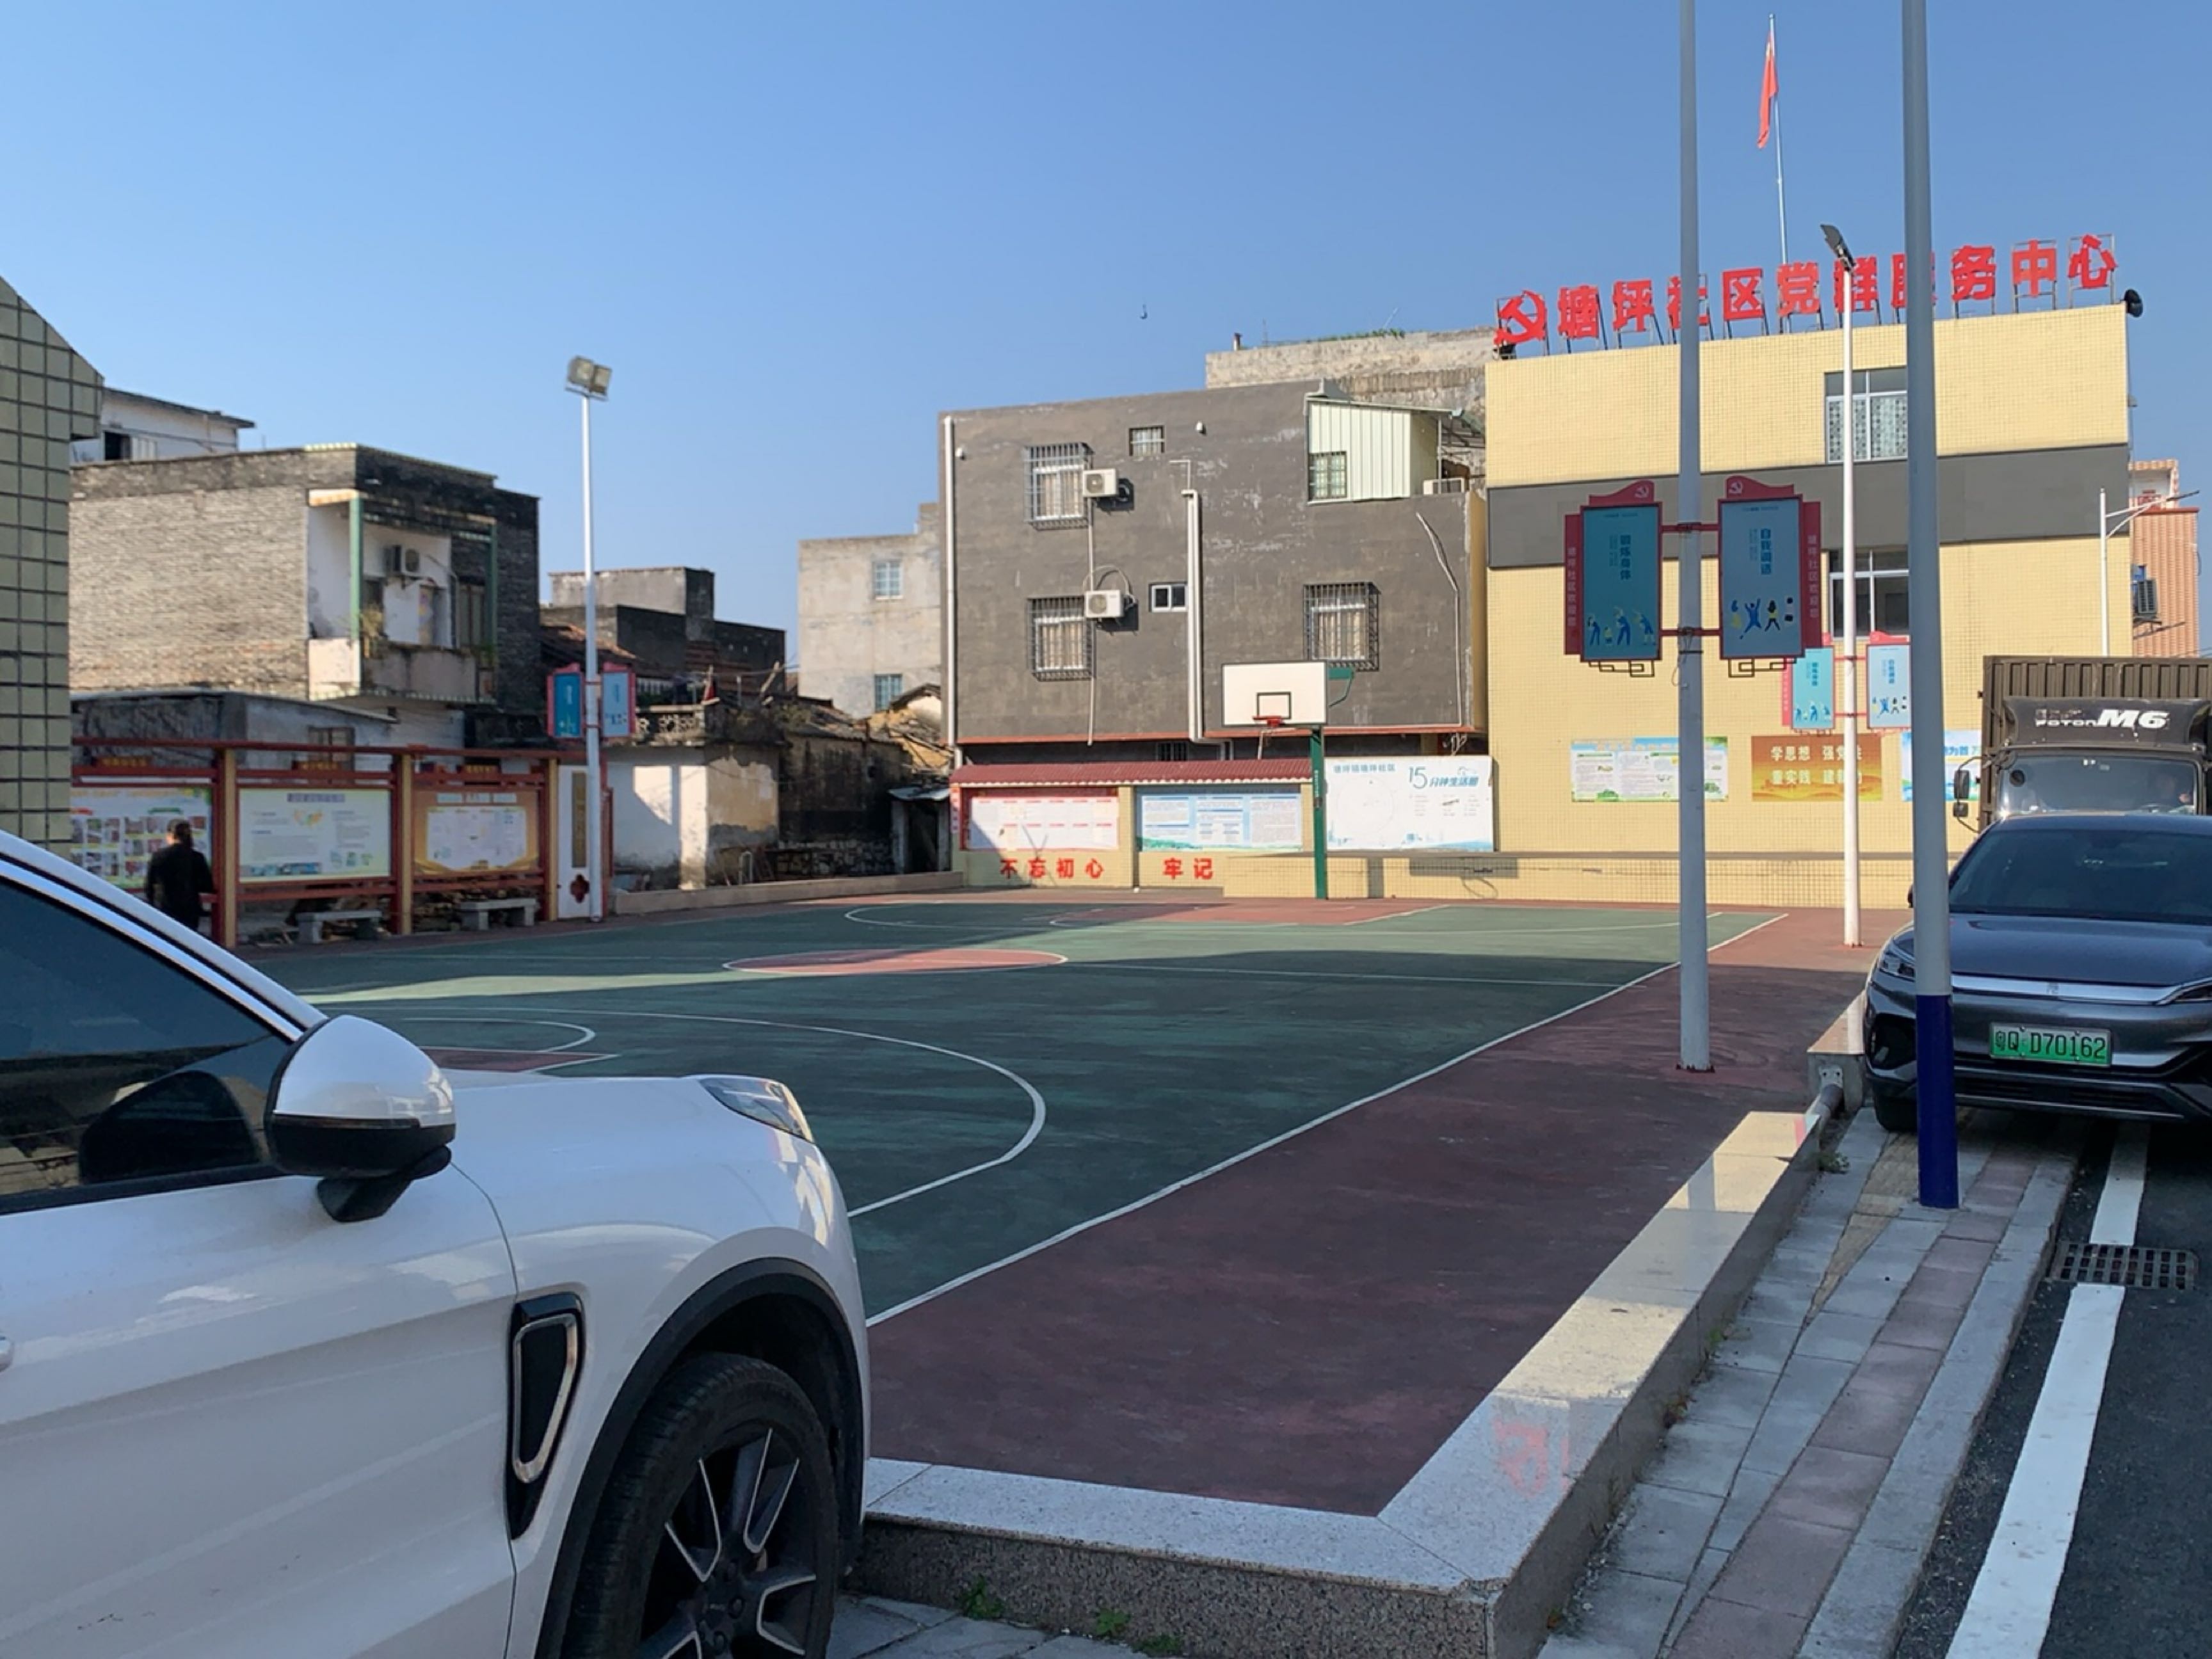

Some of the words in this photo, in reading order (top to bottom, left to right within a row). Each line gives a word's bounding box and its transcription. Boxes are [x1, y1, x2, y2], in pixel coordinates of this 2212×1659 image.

[2097, 709, 2169, 729] M6
[1770, 744, 1811, 761] 学思想
[1000, 858, 1105, 879] 不忘初心
[1163, 858, 1214, 879] 牢记
